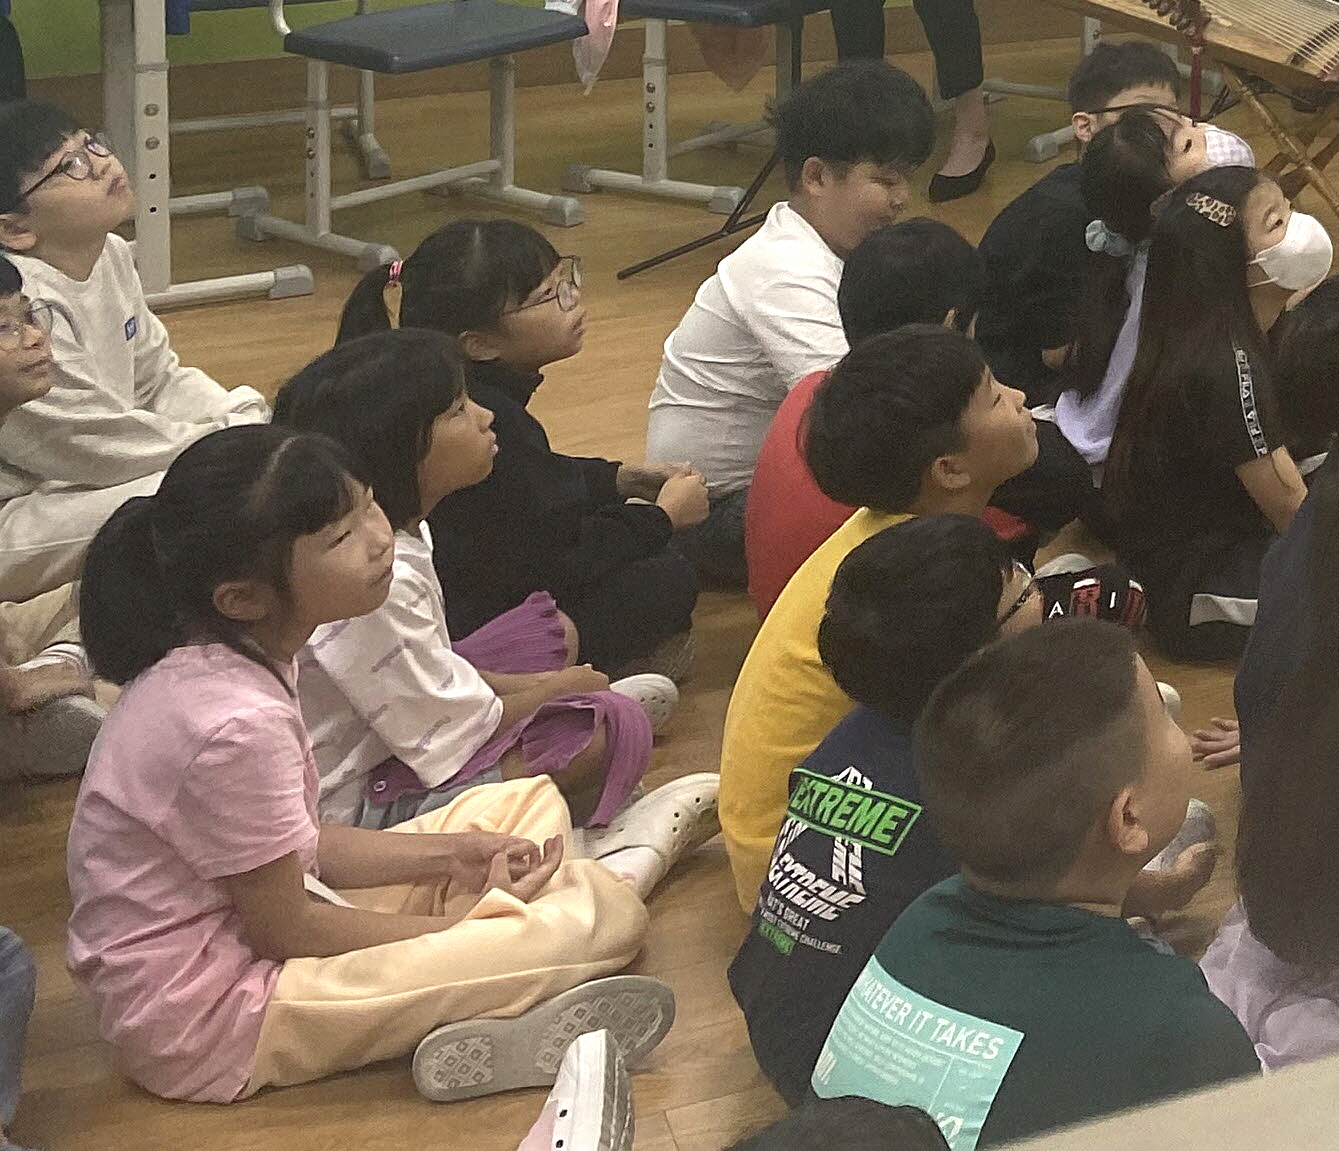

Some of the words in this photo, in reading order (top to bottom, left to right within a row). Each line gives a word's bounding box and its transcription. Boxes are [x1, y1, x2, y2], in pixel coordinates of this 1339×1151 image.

[1048, 601, 1064, 619] A
[791, 776, 908, 844] EXTREME
[908, 1005, 934, 1033] IT
[929, 1018, 1005, 1060] TAKES
